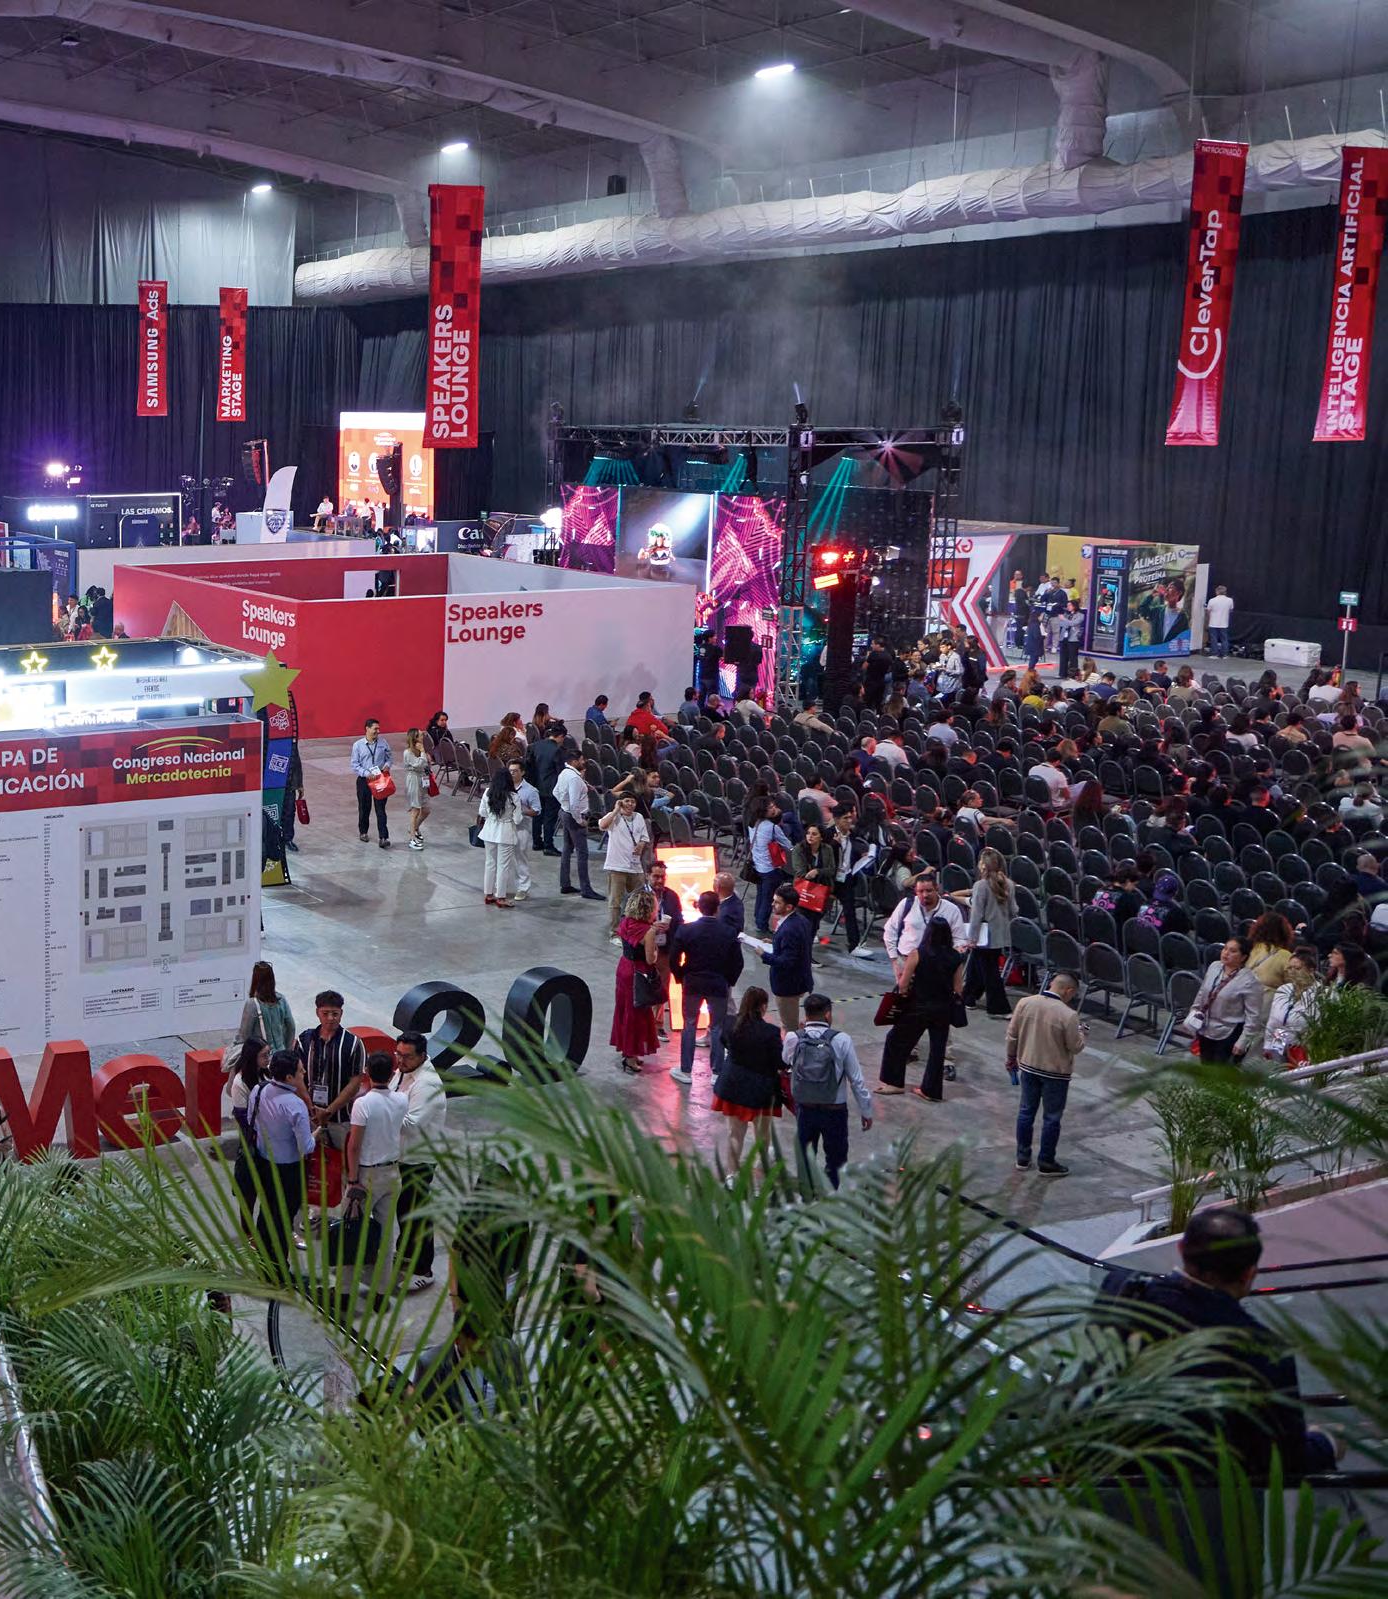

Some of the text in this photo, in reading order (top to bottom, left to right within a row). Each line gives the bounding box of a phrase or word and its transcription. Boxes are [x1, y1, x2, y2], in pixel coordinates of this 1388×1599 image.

[1189, 209, 1223, 356] CleverTap
[1325, 157, 1365, 432] INTELIGENCIA ARTIFICIAL
[146, 290, 159, 321] Ads
[146, 328, 159, 408] SAMSUNG
[221, 335, 233, 417] MARKETING
[432, 303, 453, 439] SPEAKERS
[451, 329, 470, 438] LOUNGE
[232, 373, 242, 417] STAGE
[1338, 337, 1363, 431] STAGE
[1133, 552, 1178, 570] ALIMENTA
[242, 599, 296, 627] Speakers
[448, 601, 543, 625] Speakers
[242, 621, 286, 650] Lounge
[447, 625, 526, 644] Lounge
[32, 747, 58, 765] DE
[112, 748, 245, 771] Congreso Nacional
[126, 765, 232, 785] Mercadotecnia
